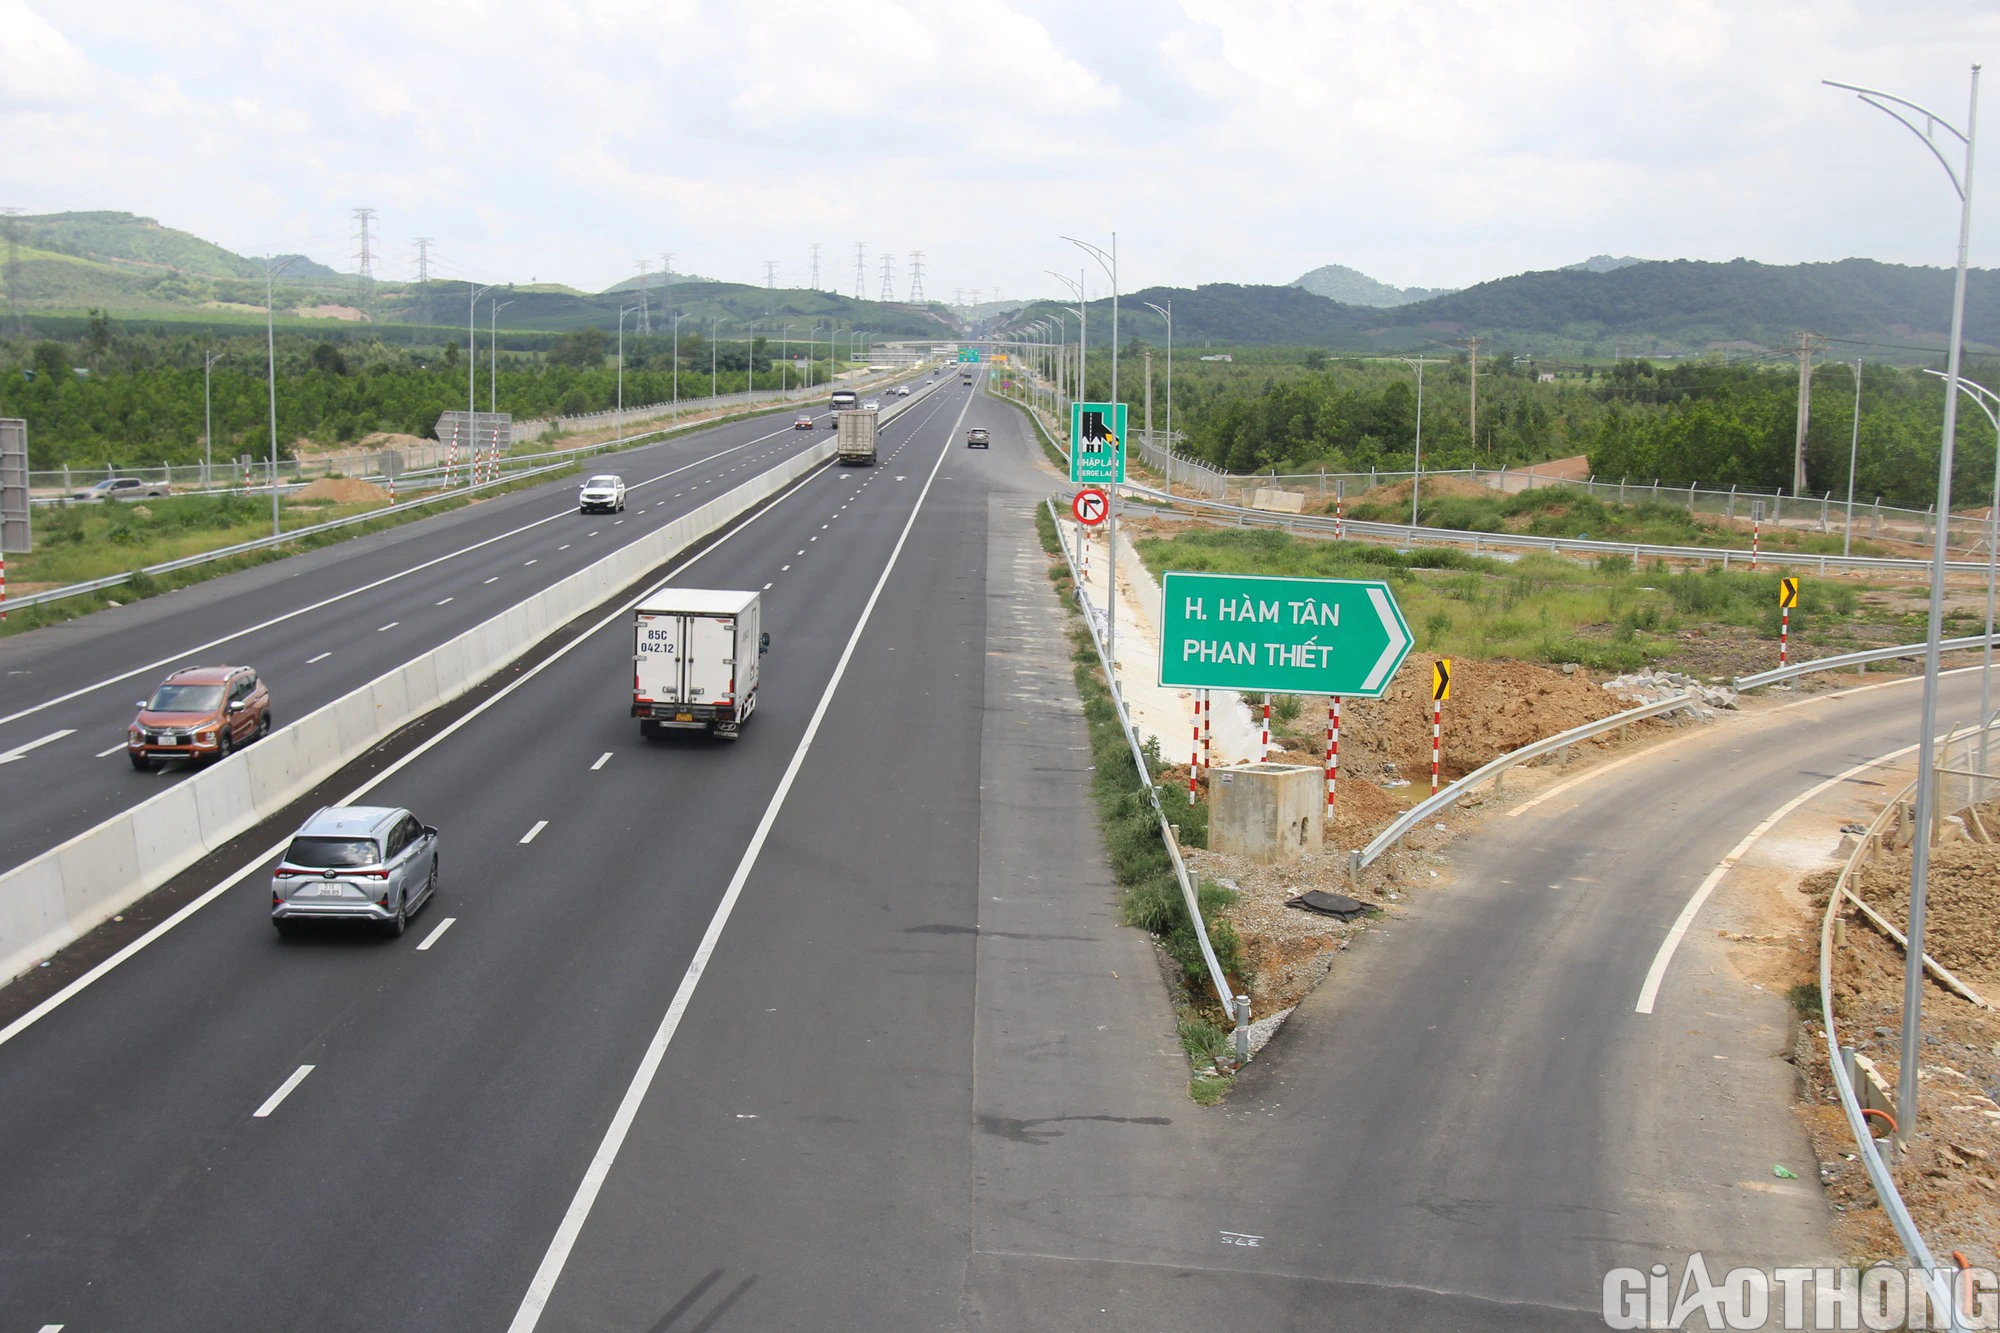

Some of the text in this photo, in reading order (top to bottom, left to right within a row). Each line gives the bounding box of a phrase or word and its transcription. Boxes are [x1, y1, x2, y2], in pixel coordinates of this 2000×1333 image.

[1185, 593, 1340, 627] H. HÀM TÂN
[648, 630, 667, 640] 85C
[641, 642, 674, 654] 042.12
[1183, 635, 1334, 669] PHAN THIẾT
